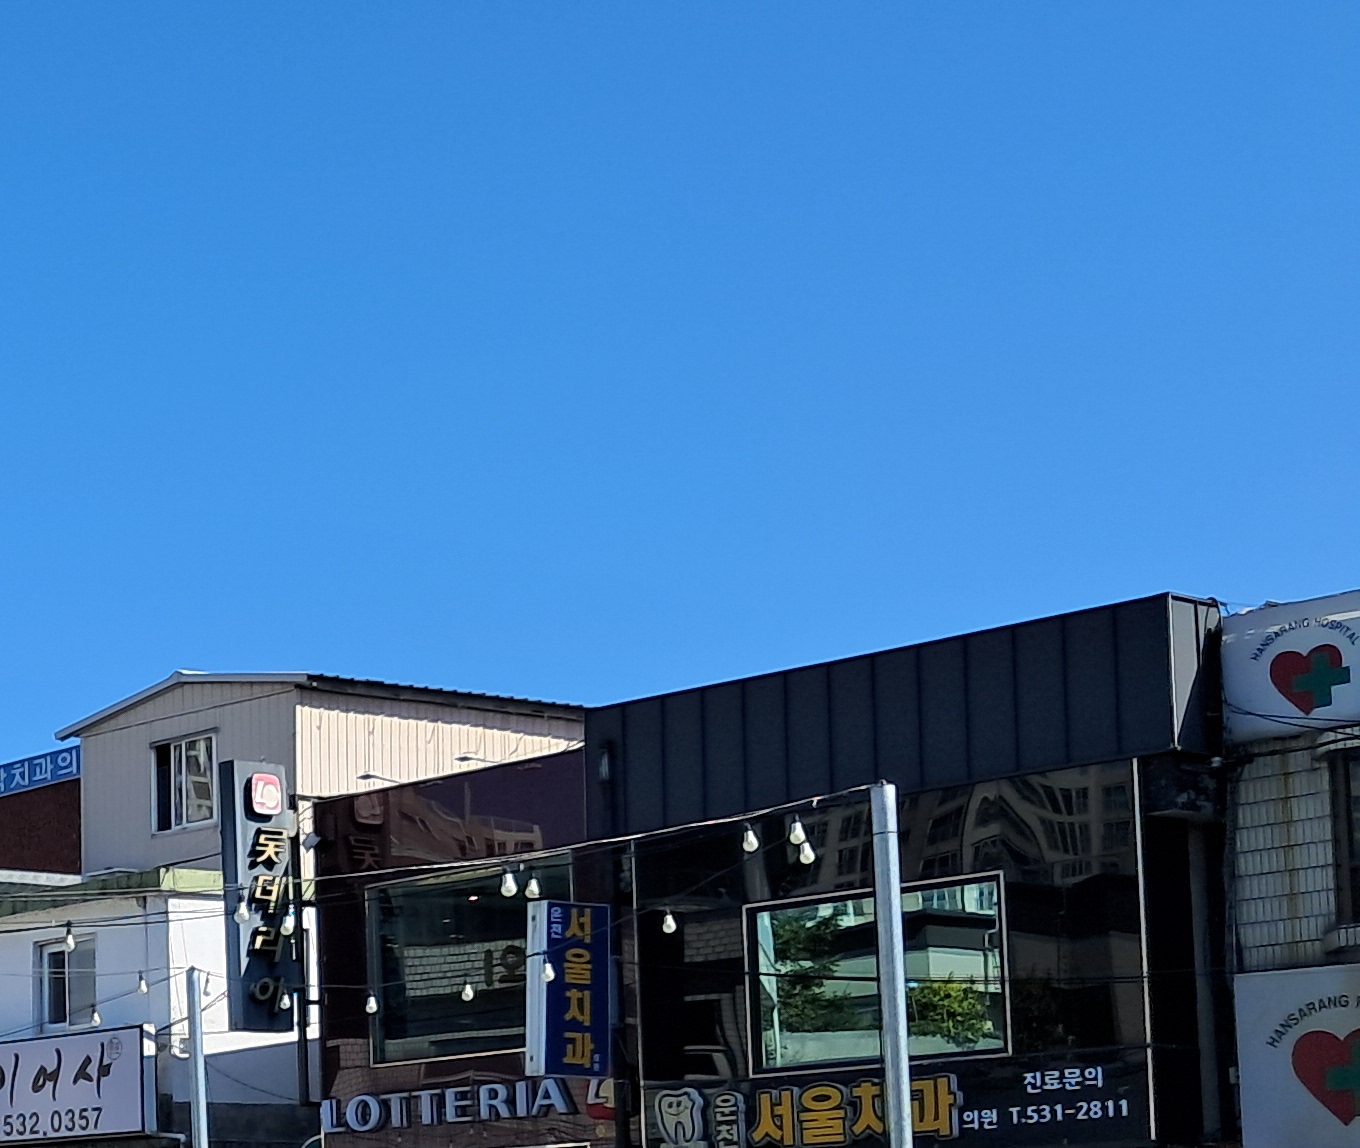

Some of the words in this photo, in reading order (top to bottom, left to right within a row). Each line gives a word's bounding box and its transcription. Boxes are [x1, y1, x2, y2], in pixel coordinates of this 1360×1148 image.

[1250, 617, 1310, 662] HANSARANG
[1314, 616, 1360, 646] HOSPITAL
[563, 908, 595, 1068] 서울치과
[1265, 994, 1350, 1049] HANSARANG
[1023, 1066, 1103, 1094] 진료문의
[320, 1078, 570, 1133] LOTTERIA
[962, 1108, 998, 1131] 의원
[1008, 1099, 1129, 1125] T.531-2811
